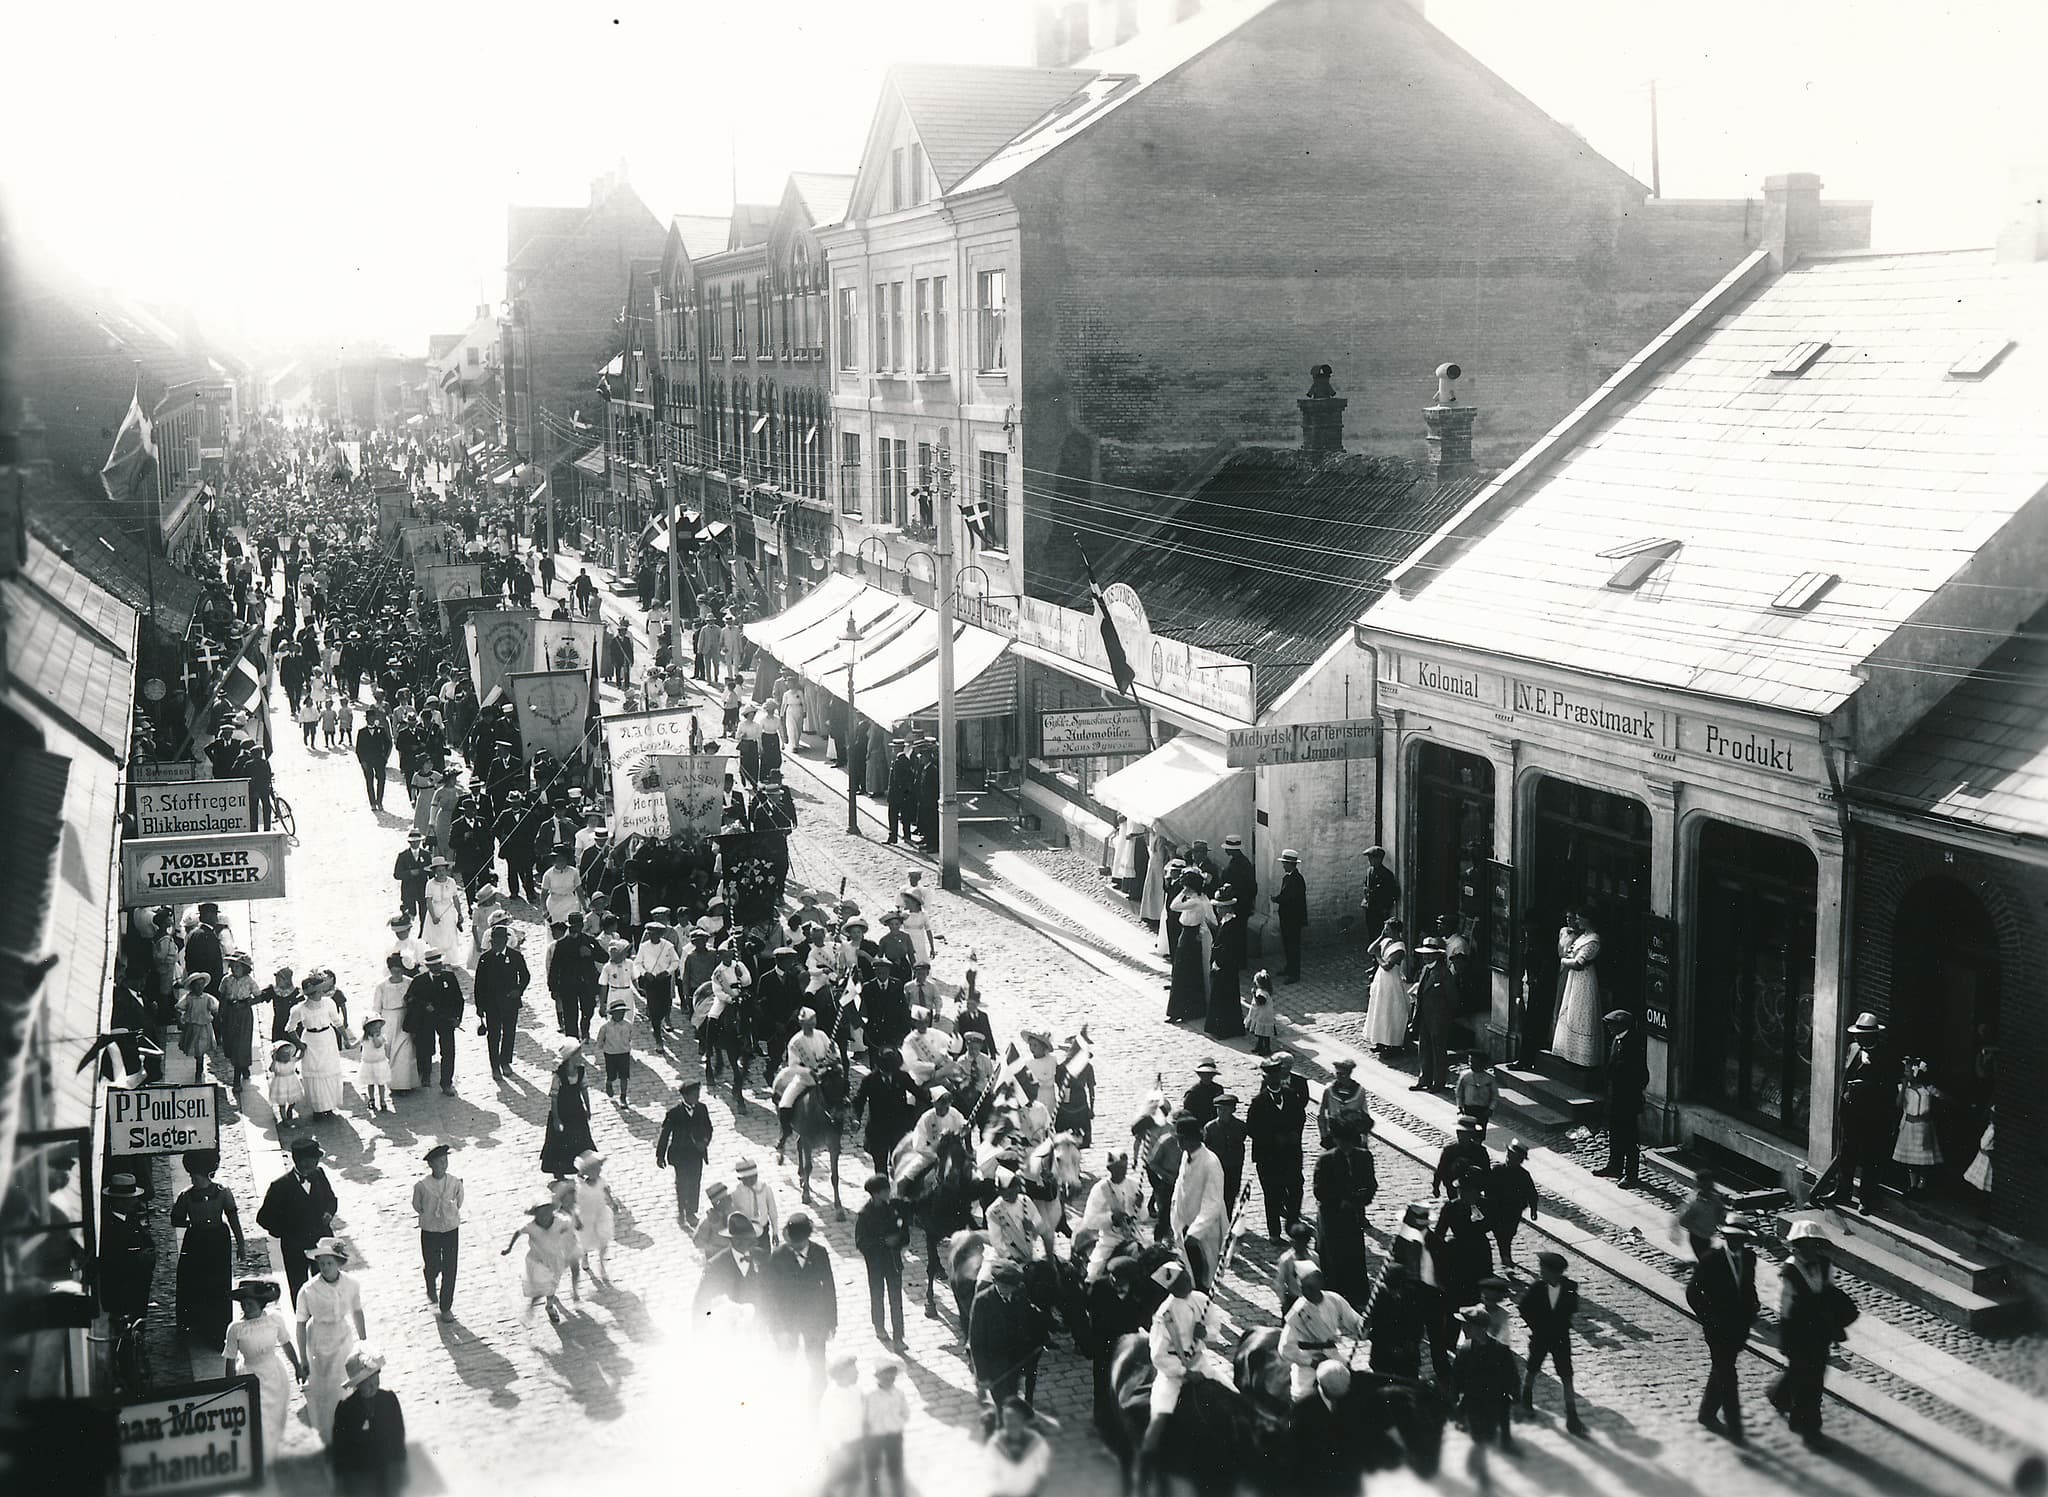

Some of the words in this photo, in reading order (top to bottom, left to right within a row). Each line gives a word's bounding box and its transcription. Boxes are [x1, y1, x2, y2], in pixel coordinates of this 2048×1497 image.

[1418, 661, 1479, 698] Kolonial
[1257, 753, 1267, 763] &
[1706, 725, 1794, 772] Produkt
[666, 774, 720, 789] SKANSEN
[160, 851, 249, 870] MØBLER
[148, 867, 260, 888] LIGKISTER
[1646, 1008, 1667, 1029] OMA
[129, 1125, 202, 1149] Slagter.
